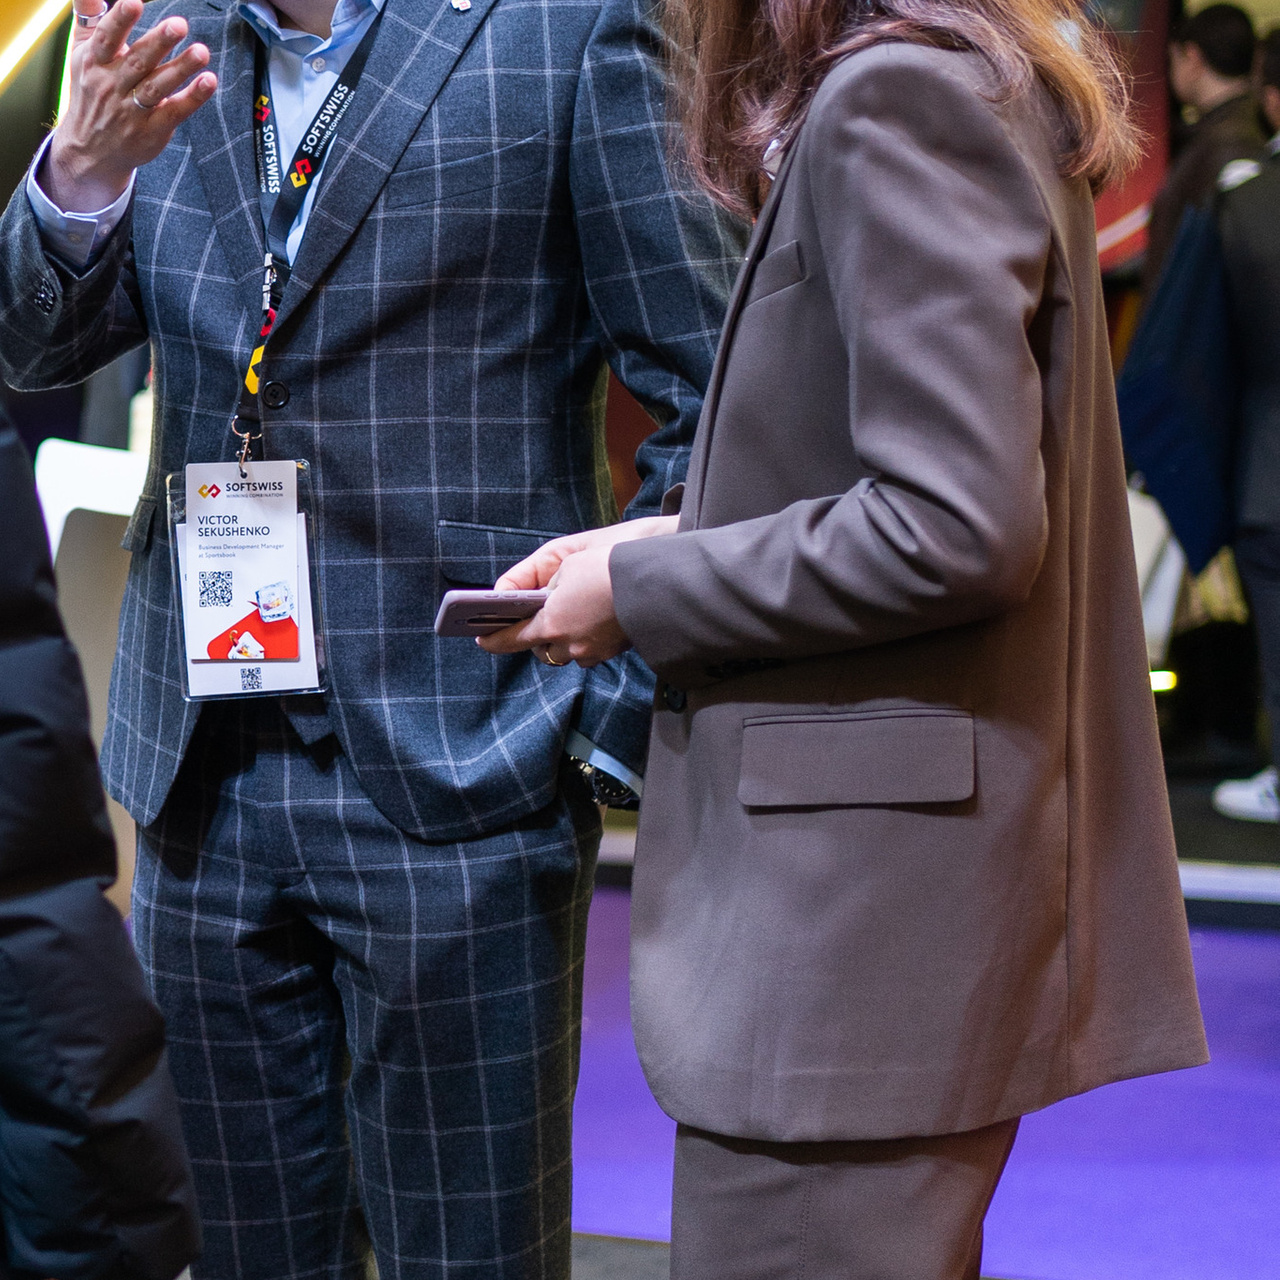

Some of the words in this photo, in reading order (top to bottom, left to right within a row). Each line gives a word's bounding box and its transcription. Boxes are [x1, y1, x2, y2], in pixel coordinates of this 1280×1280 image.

[302, 83, 349, 154] SOFTSWISS
[314, 130, 332, 158] WINNING
[328, 90, 356, 131] COMBINATION
[262, 124, 281, 194] SOFTSWISS
[225, 481, 284, 492] SOFTSWISS
[197, 515, 239, 525] VICTOR
[197, 526, 271, 537] SEKUSHENKO
[223, 543, 259, 551] Development
